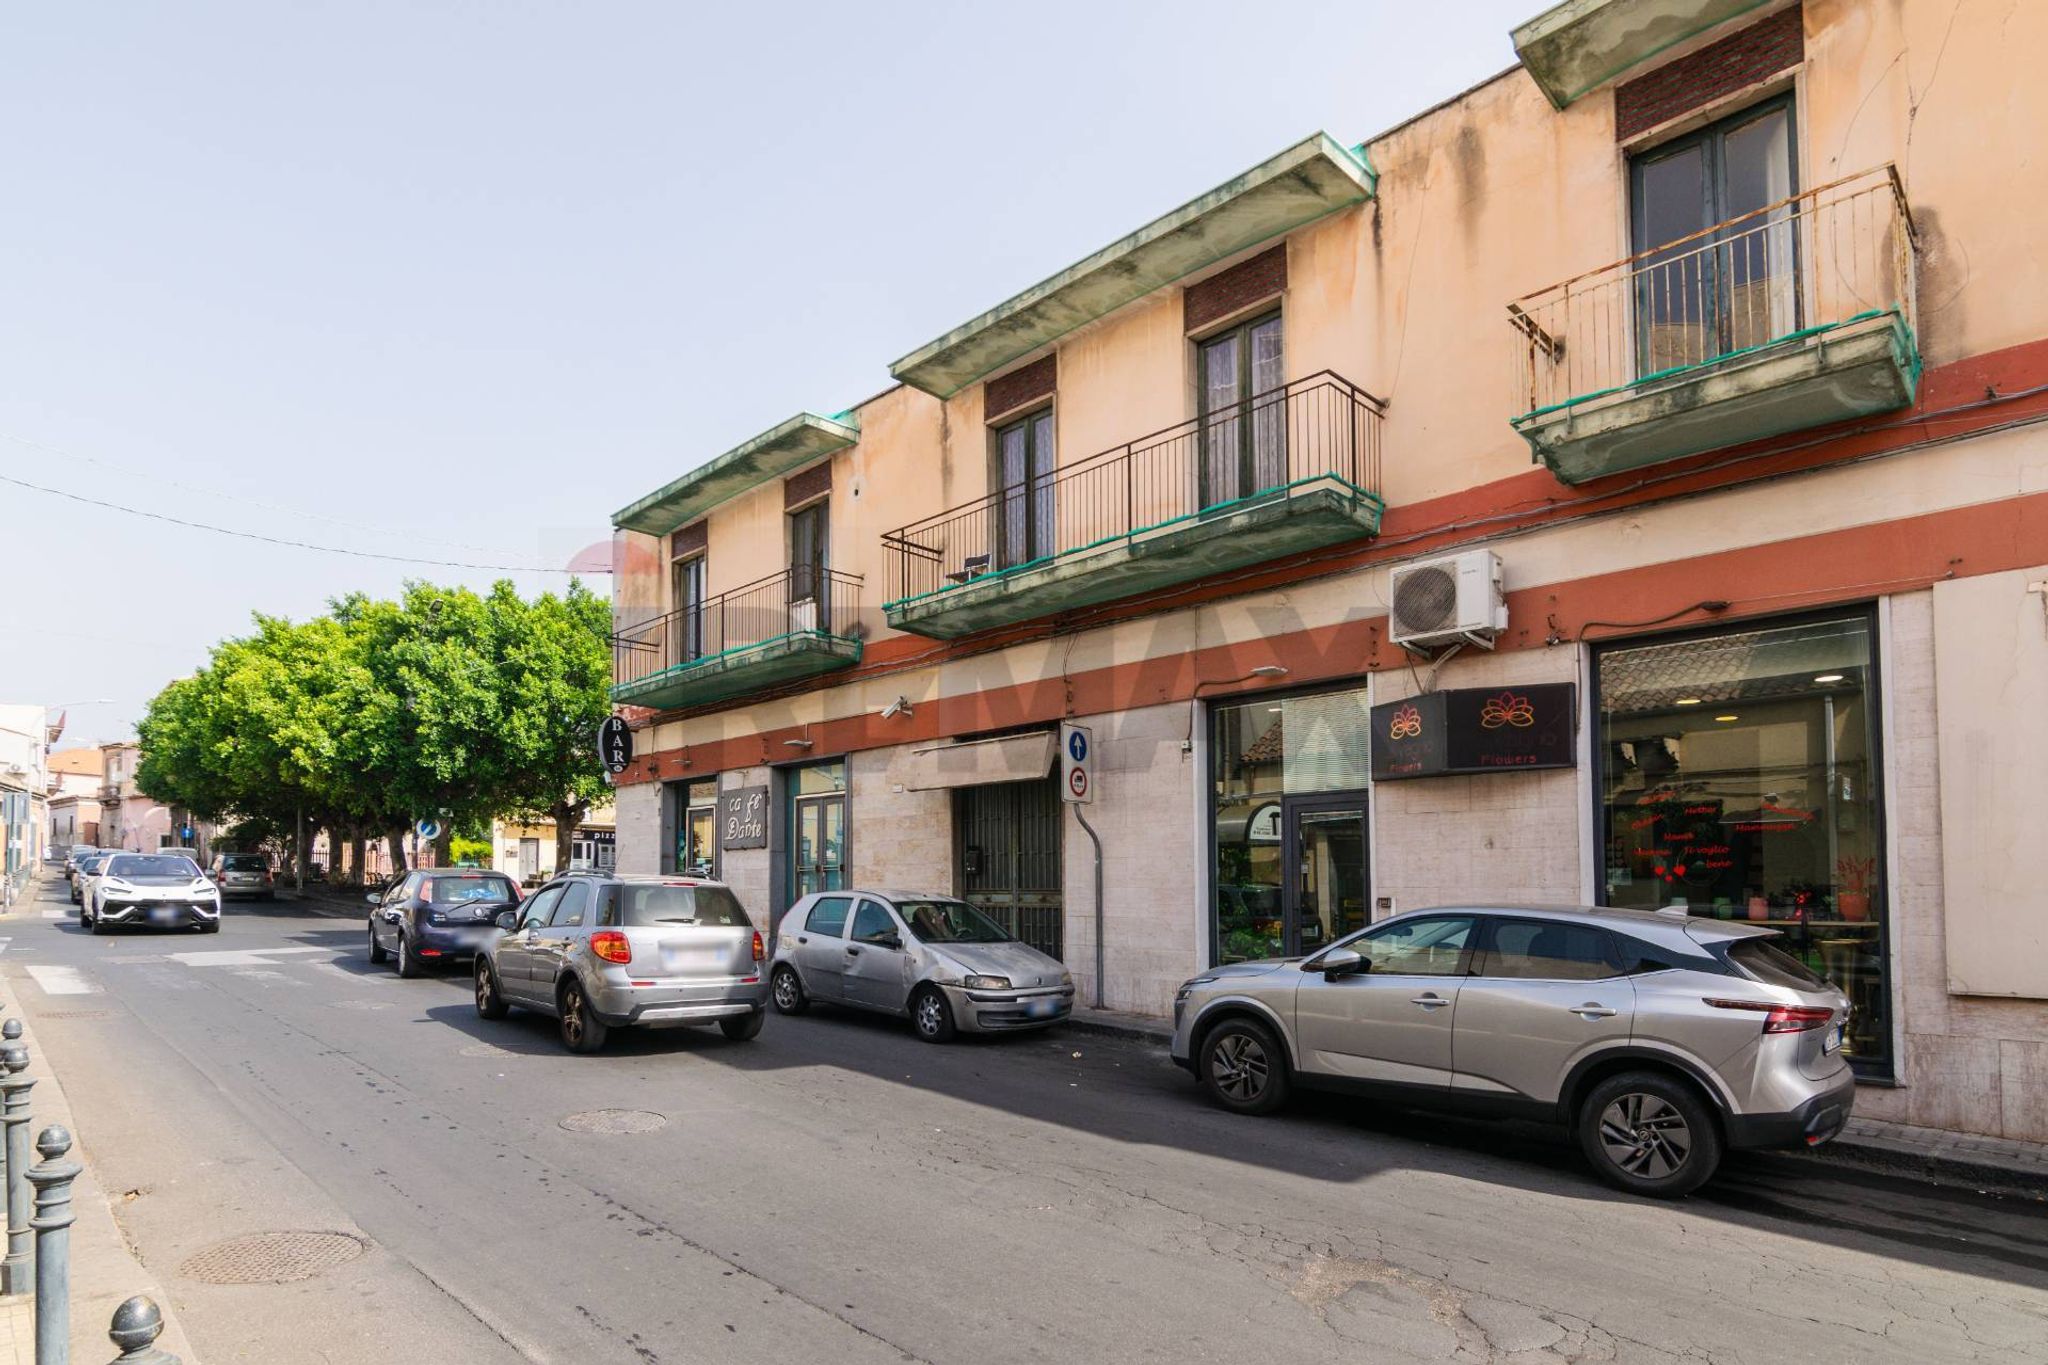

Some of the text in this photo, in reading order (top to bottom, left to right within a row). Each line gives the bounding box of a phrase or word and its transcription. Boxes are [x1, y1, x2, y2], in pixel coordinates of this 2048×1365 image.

[611, 719, 624, 763] BAR
[1480, 753, 1537, 766] Flowers
[725, 816, 761, 840] Dante
